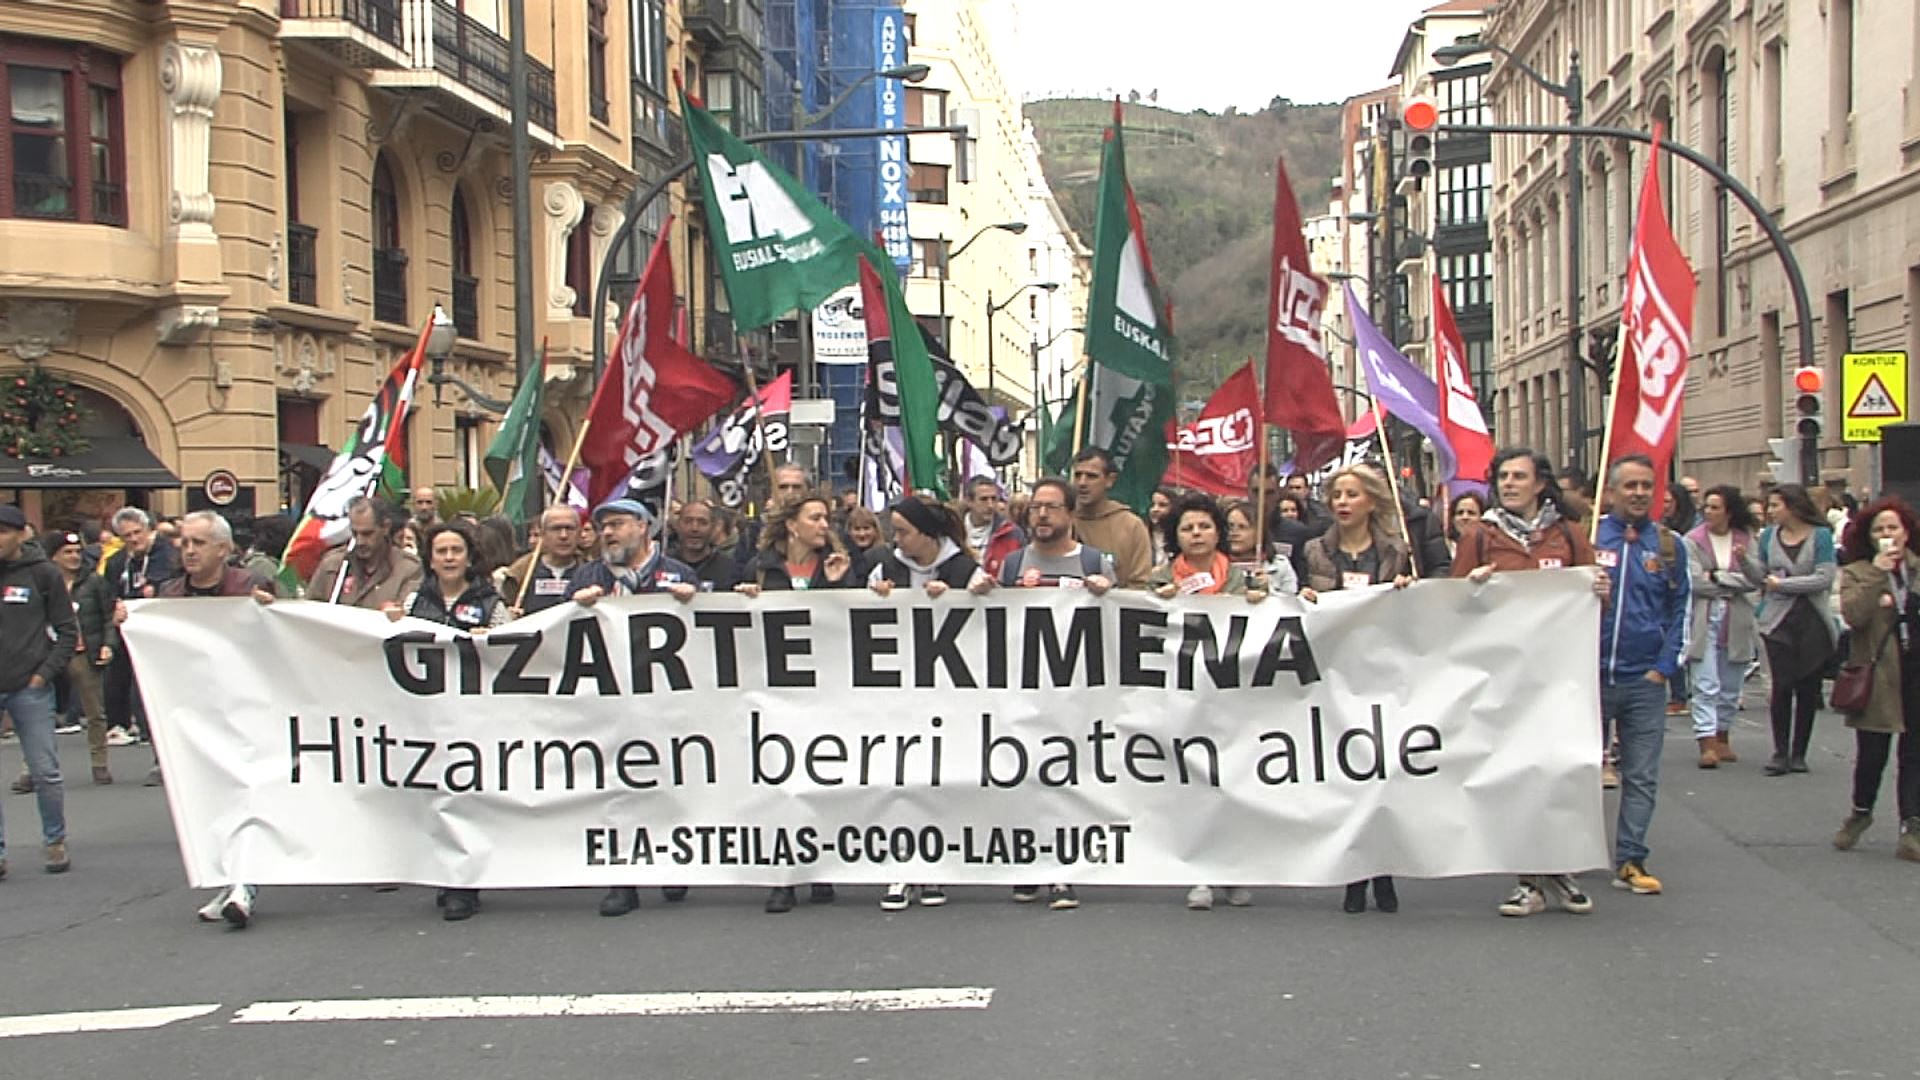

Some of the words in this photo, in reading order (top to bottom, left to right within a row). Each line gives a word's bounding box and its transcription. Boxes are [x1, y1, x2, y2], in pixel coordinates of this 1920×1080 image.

[881, 15, 897, 116] ANDAIOS
[384, 609, 816, 695] GIZARTE
[850, 607, 1321, 690] EKIMENA
[290, 717, 715, 792] Hitzarmen
[752, 712, 941, 786] berri
[981, 714, 1219, 788] baten
[1258, 705, 1441, 784] alde
[587, 826, 1130, 867] ELA-STEILAS-CCOO-LAB-UGT
